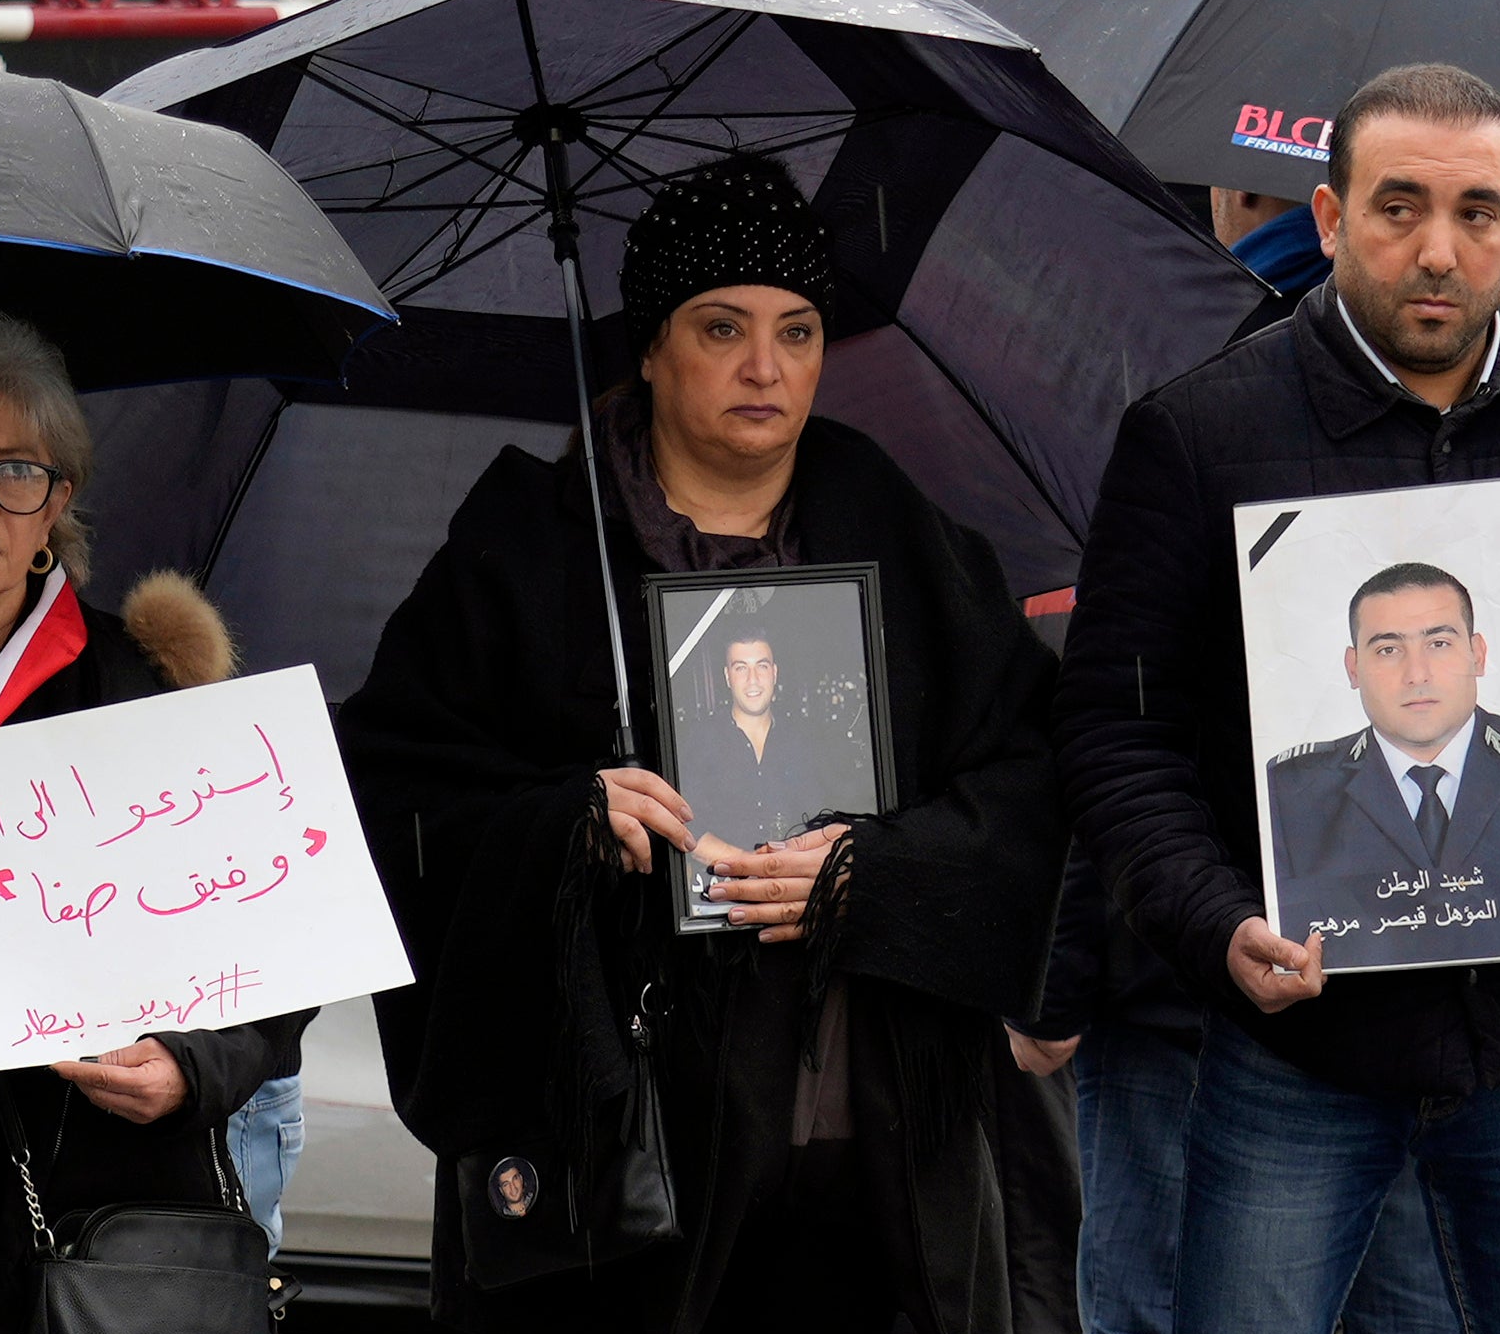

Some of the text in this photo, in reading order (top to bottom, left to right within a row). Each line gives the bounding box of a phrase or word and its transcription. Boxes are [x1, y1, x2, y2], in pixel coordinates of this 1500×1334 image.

[1376, 866, 1484, 899] شهيد الوطن
[1371, 905, 1428, 934] قيصر
[1435, 900, 1497, 927] المؤهل
